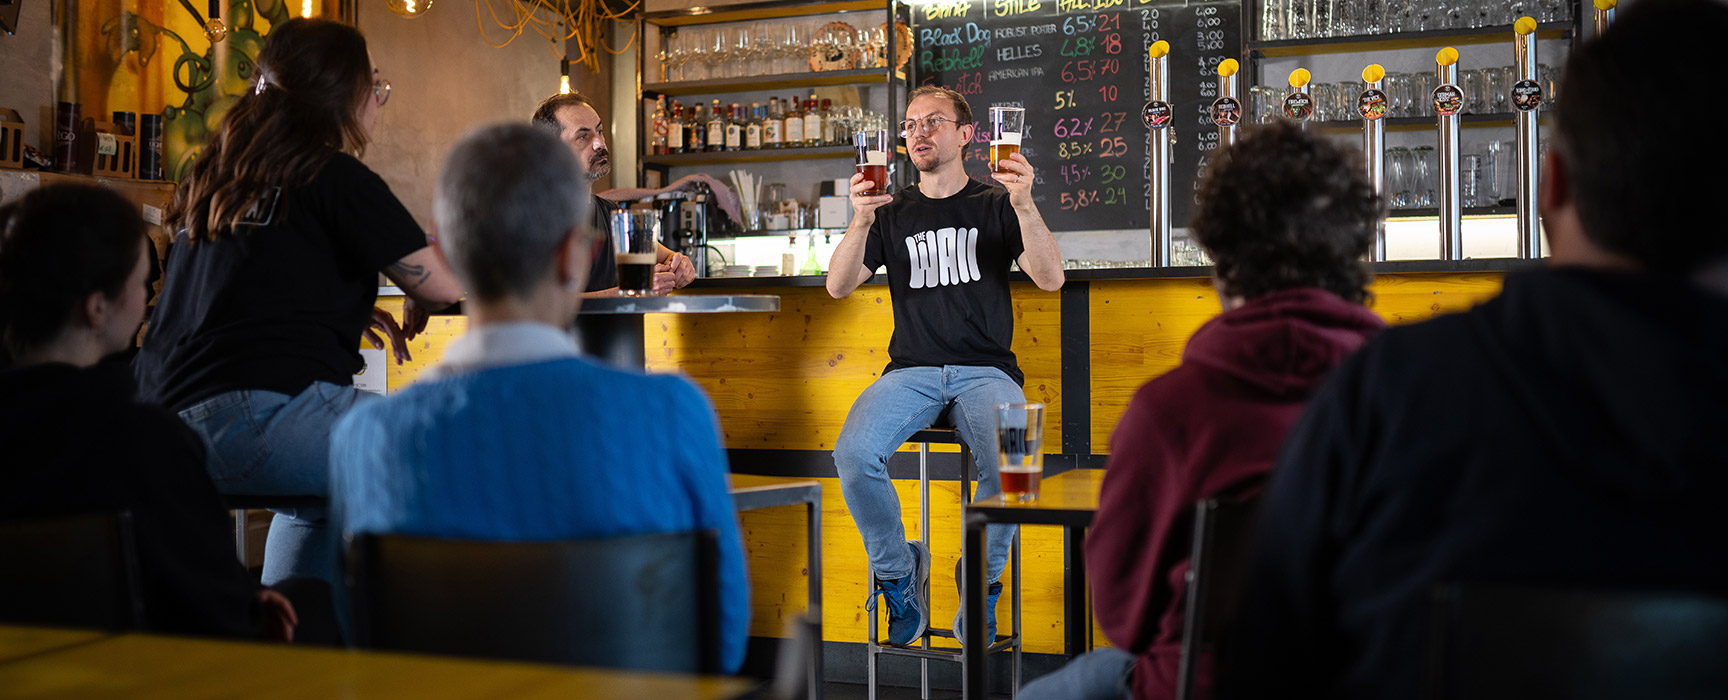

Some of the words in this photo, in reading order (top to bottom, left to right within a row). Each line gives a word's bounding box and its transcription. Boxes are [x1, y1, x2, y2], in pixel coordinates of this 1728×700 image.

[1098, 12, 1120, 31] 21
[1141, 9, 1159, 20] 20
[965, 22, 992, 49] Dog
[1100, 33, 1121, 54] 18
[996, 44, 1042, 61] HELLES
[1100, 58, 1120, 75] 70
[1054, 90, 1077, 110] 5%
[1098, 85, 1118, 102] 10
[1054, 117, 1093, 139] 6,2%
[1100, 112, 1127, 134] 27
[1059, 142, 1092, 159] 8,5%
[1099, 137, 1128, 157] 25
[1100, 164, 1126, 184] 30
[1060, 189, 1100, 211] 5,8%
[1104, 187, 1127, 205] 24
[914, 231, 926, 243] THE
